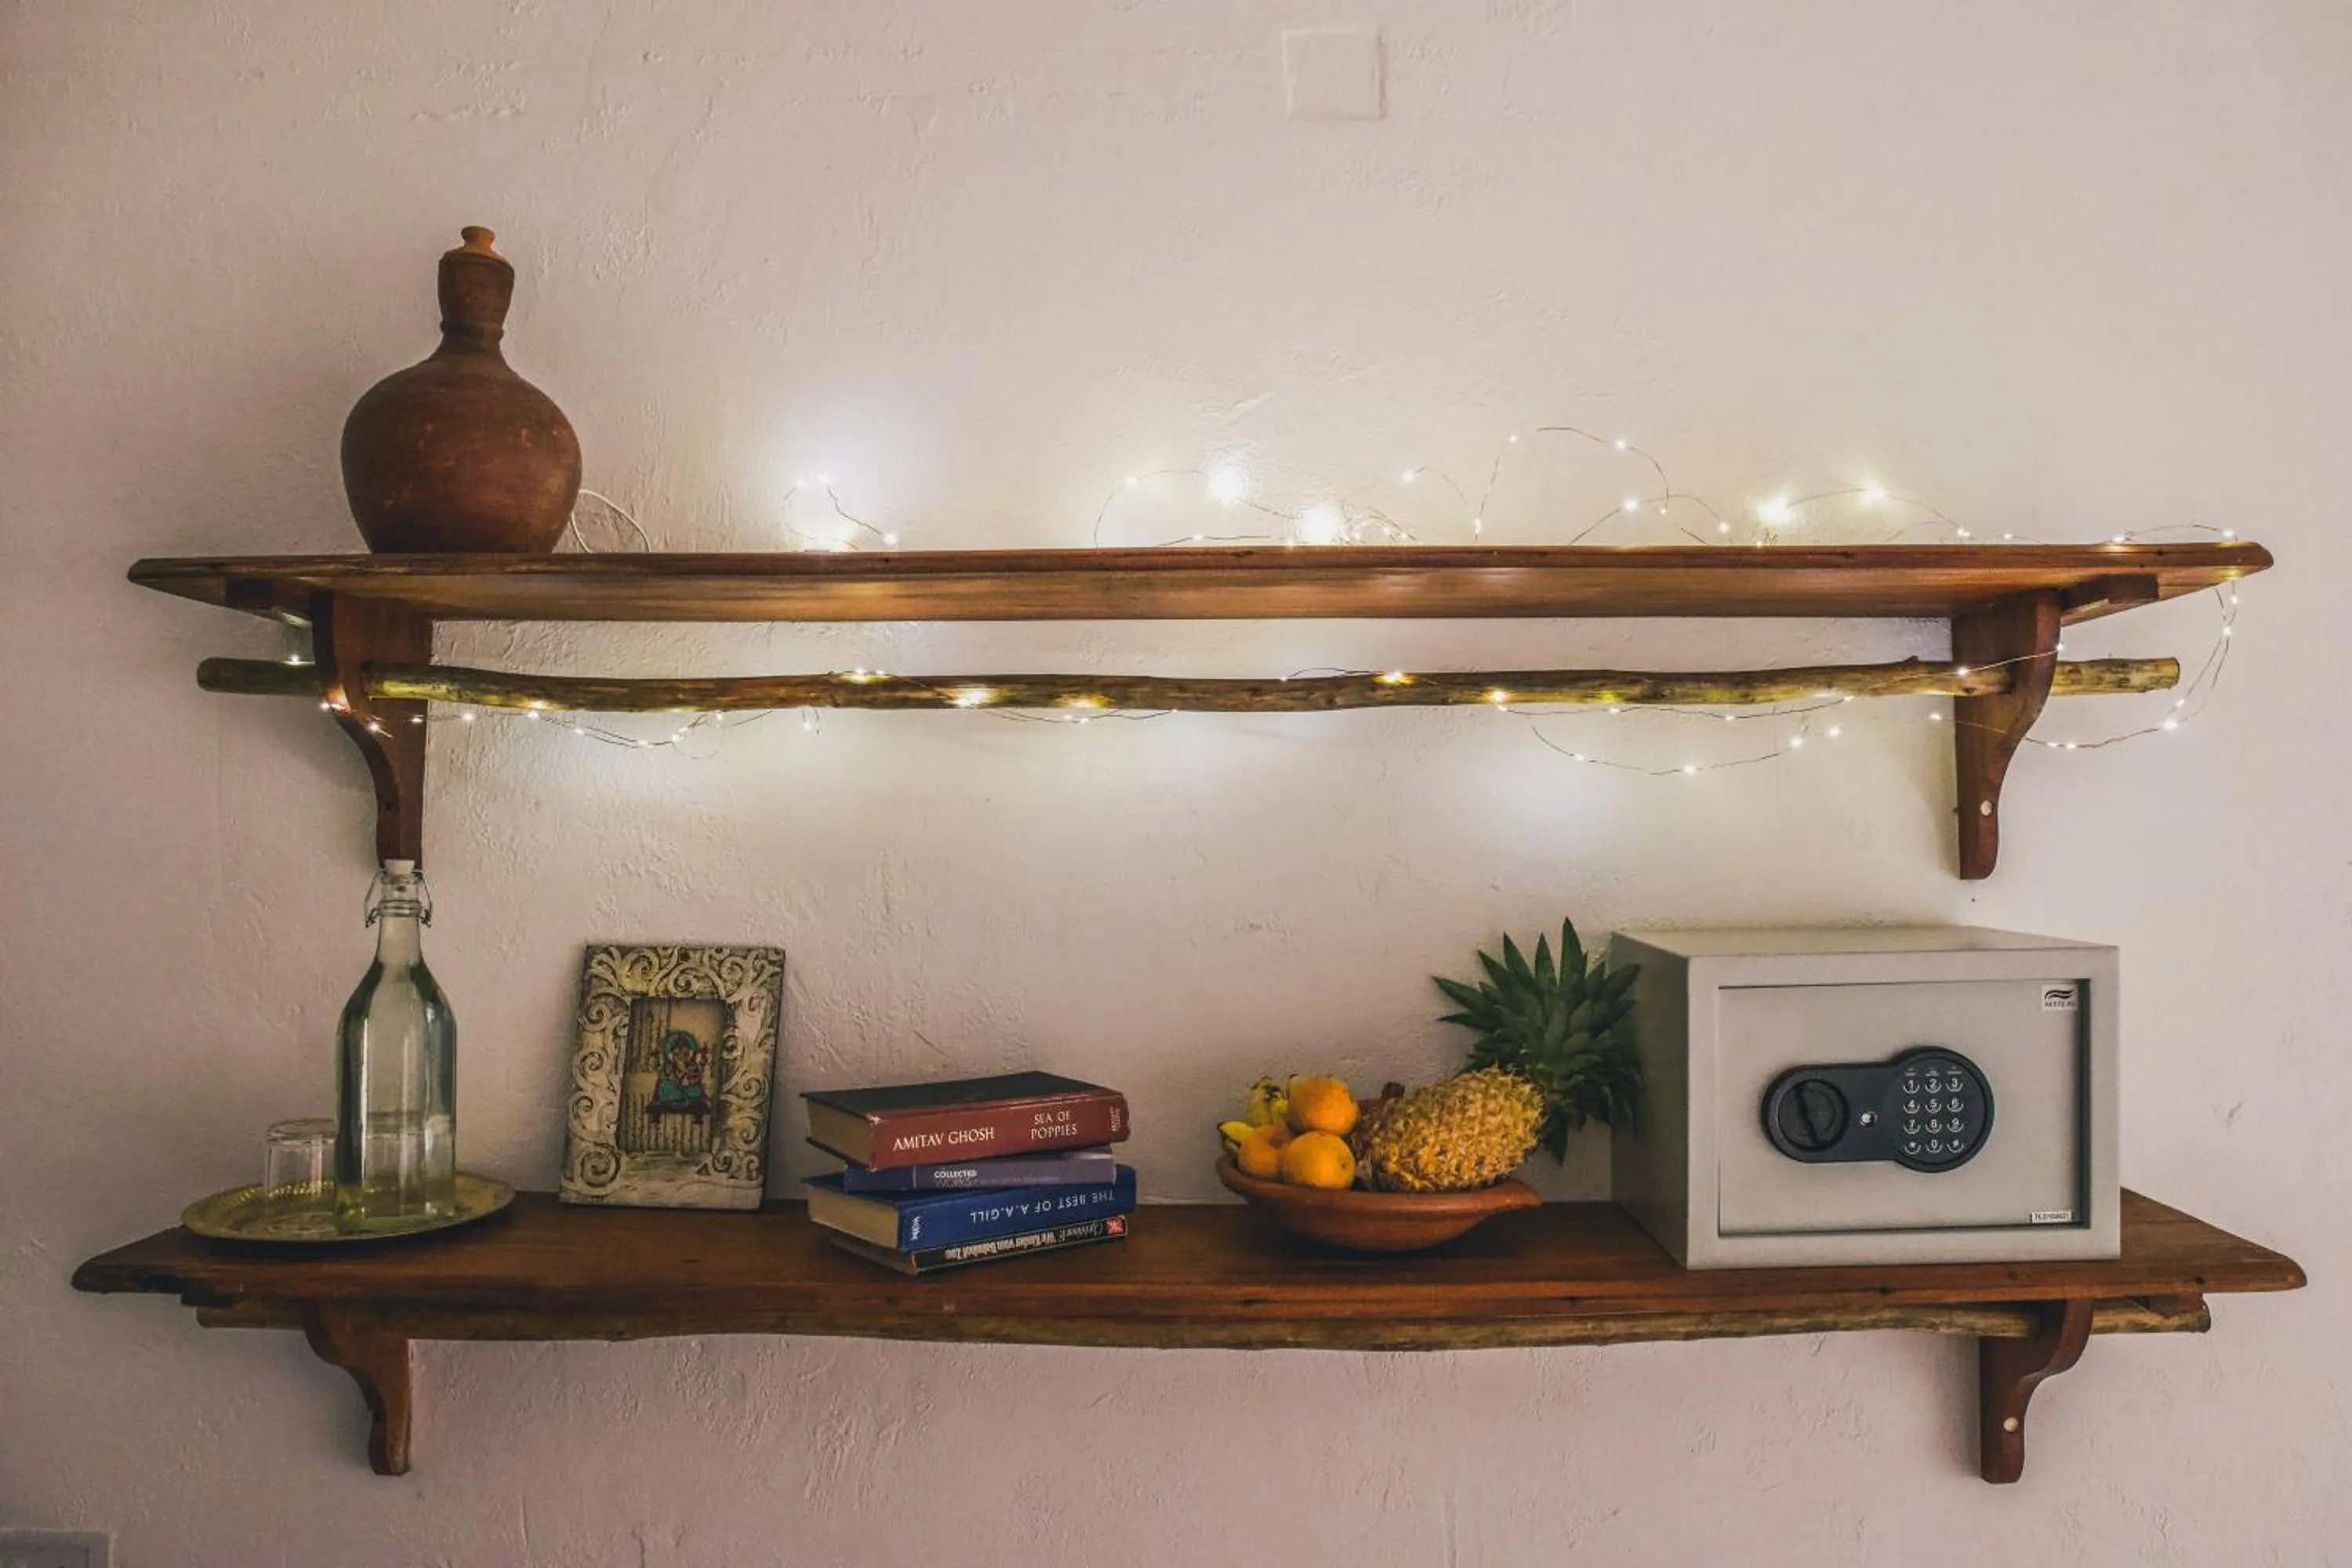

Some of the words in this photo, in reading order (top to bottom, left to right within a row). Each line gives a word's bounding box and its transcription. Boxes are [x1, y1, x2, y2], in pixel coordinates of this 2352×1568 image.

[1929, 1078, 1937, 1088] 2
[1951, 1078, 1958, 1088] 3
[1907, 1098, 1915, 1108] 4
[1930, 1098, 1937, 1108] 5
[1034, 1113, 1053, 1125] SEA
[1058, 1110, 1071, 1122] OF
[1908, 1119, 1915, 1129] 7
[1931, 1119, 1937, 1128] 8
[1031, 1123, 1078, 1140] POPPIES
[892, 1132, 944, 1152] AMITAV
[948, 1127, 995, 1145] GHOSH
[934, 1169, 978, 1178] COLLECTED
[1057, 1194, 1086, 1210] BEST
[1091, 1189, 1114, 1203] THE
[1034, 1200, 1051, 1213] OF
